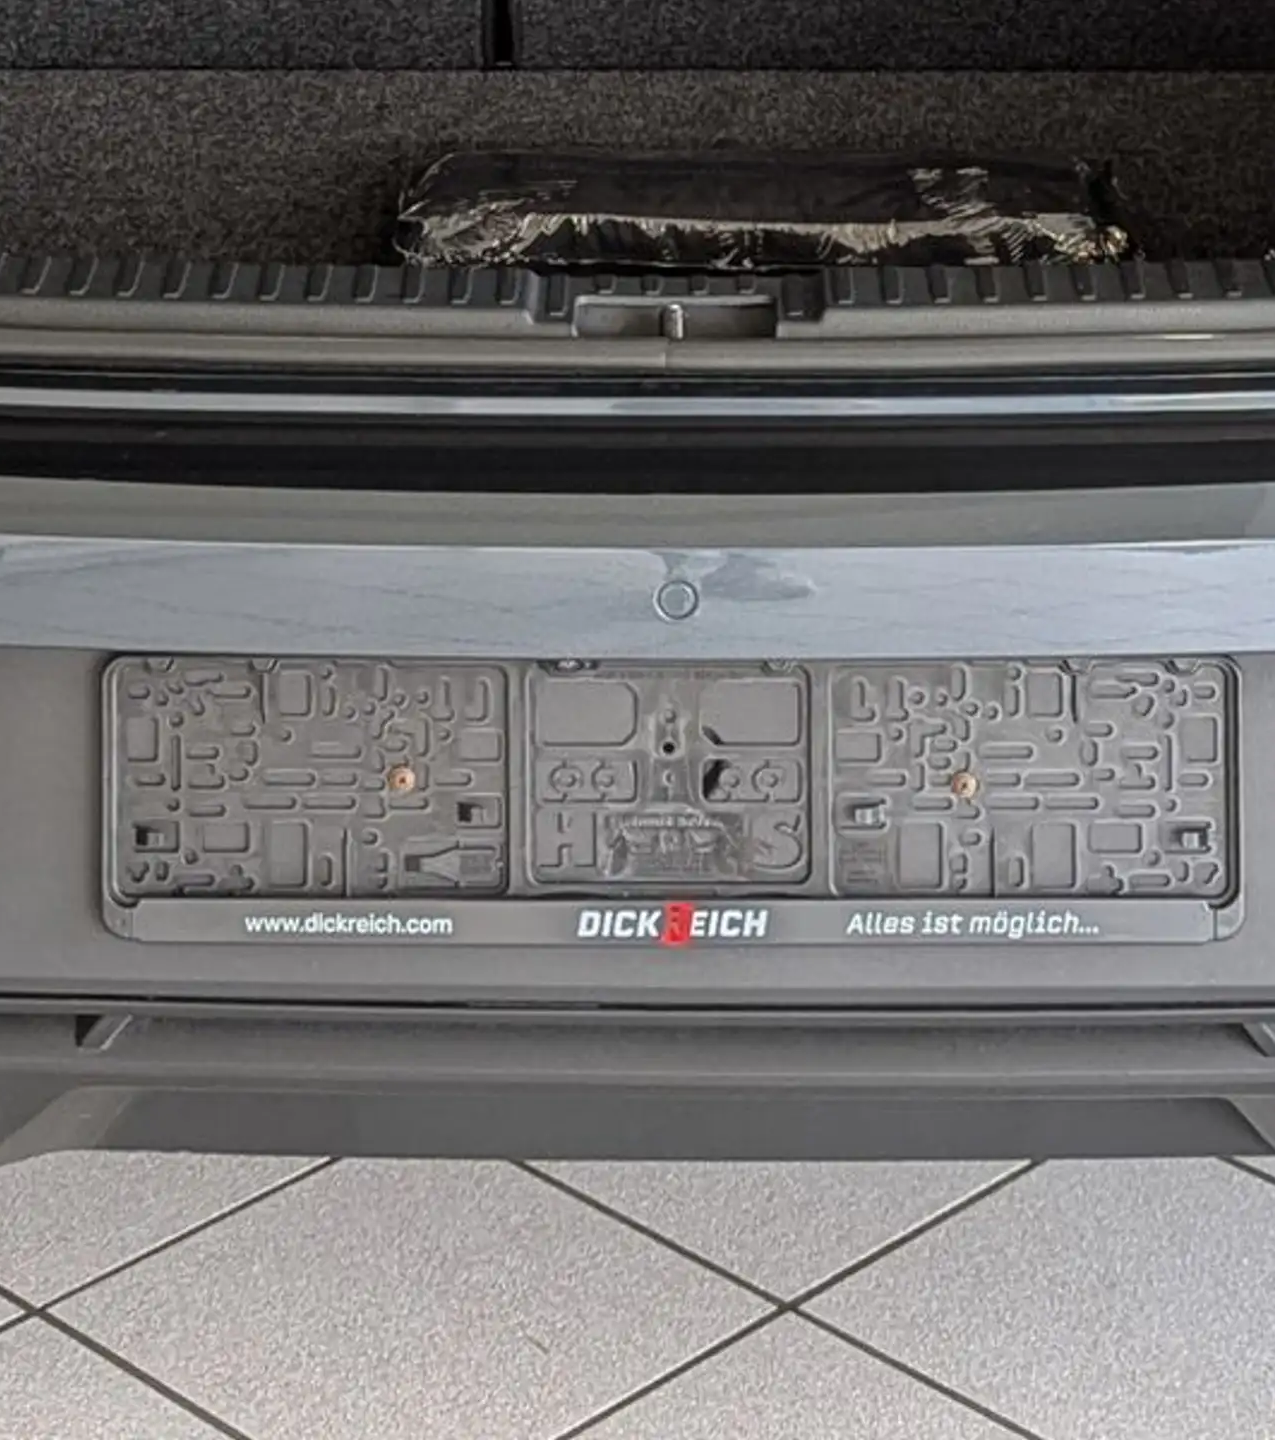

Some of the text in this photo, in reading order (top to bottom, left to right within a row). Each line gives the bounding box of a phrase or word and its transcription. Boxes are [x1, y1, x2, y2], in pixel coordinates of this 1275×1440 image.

[243, 911, 454, 934] www.dickreich.com
[846, 909, 1101, 940] Alles ist möglich...
